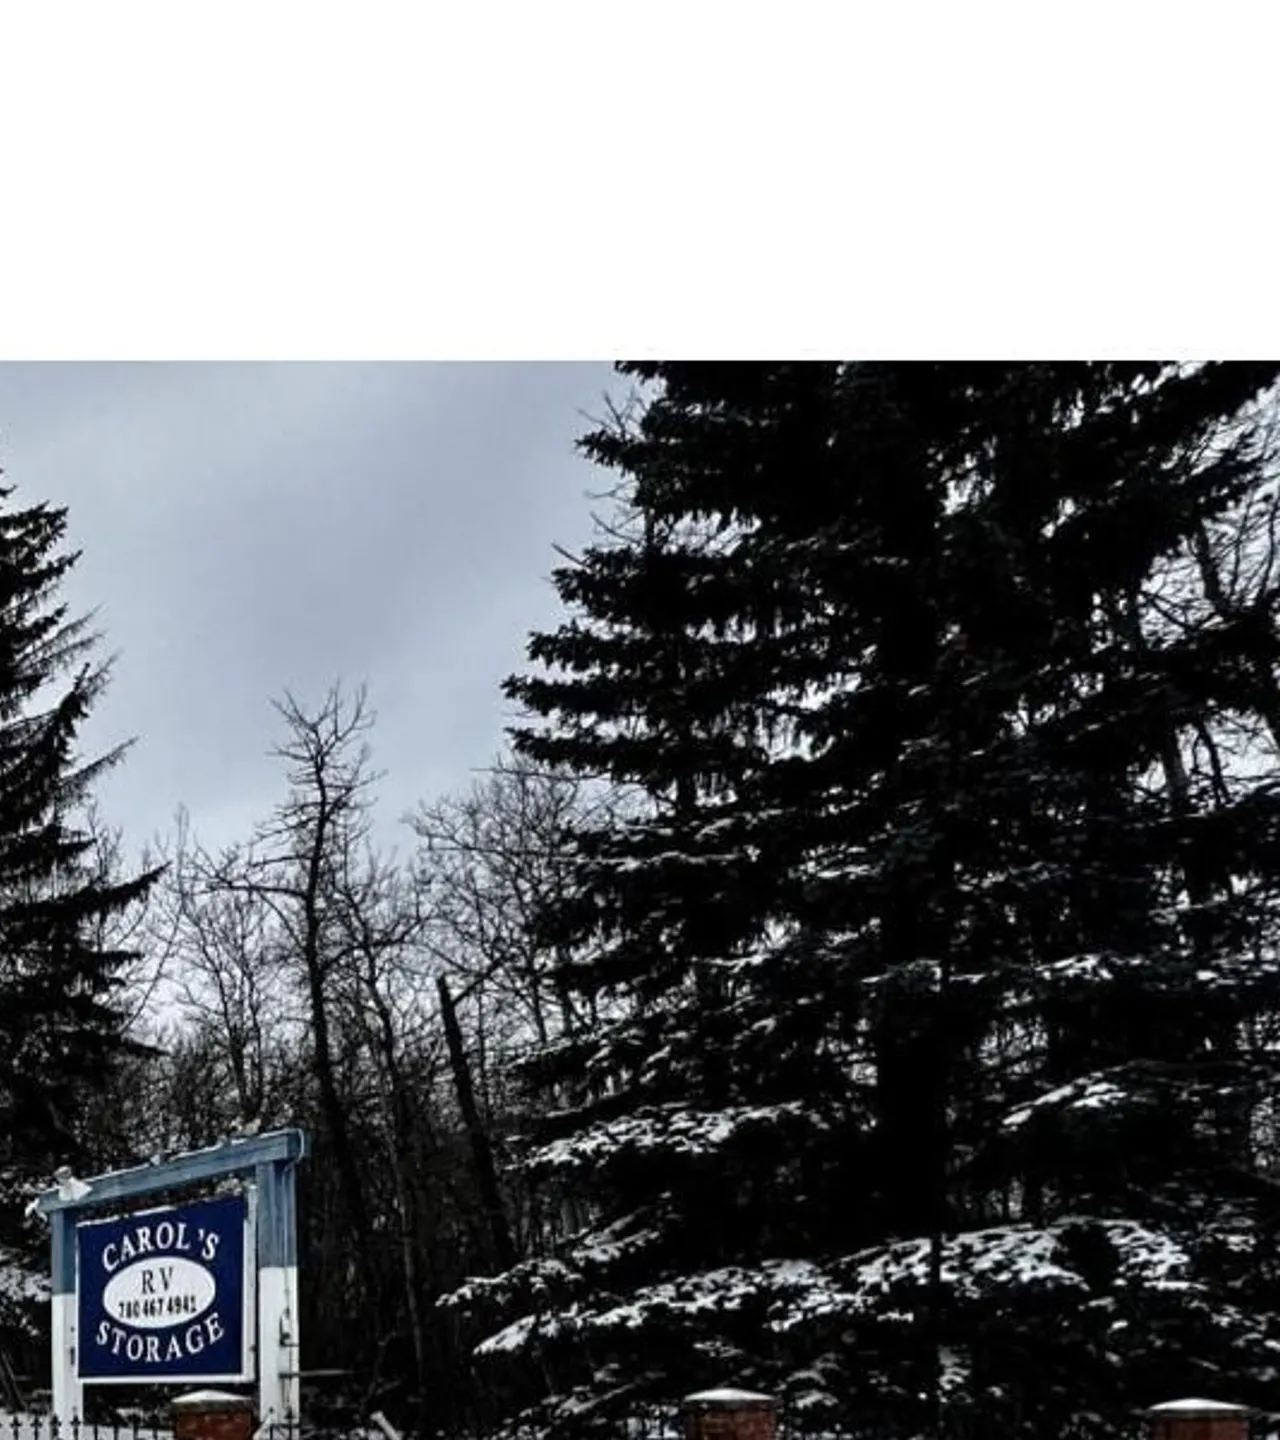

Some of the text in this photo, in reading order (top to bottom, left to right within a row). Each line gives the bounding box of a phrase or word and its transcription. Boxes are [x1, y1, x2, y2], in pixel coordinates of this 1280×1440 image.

[102, 1221, 220, 1272] CAROL'S
[142, 1266, 173, 1294] RV
[96, 1312, 224, 1362] STORAGE
